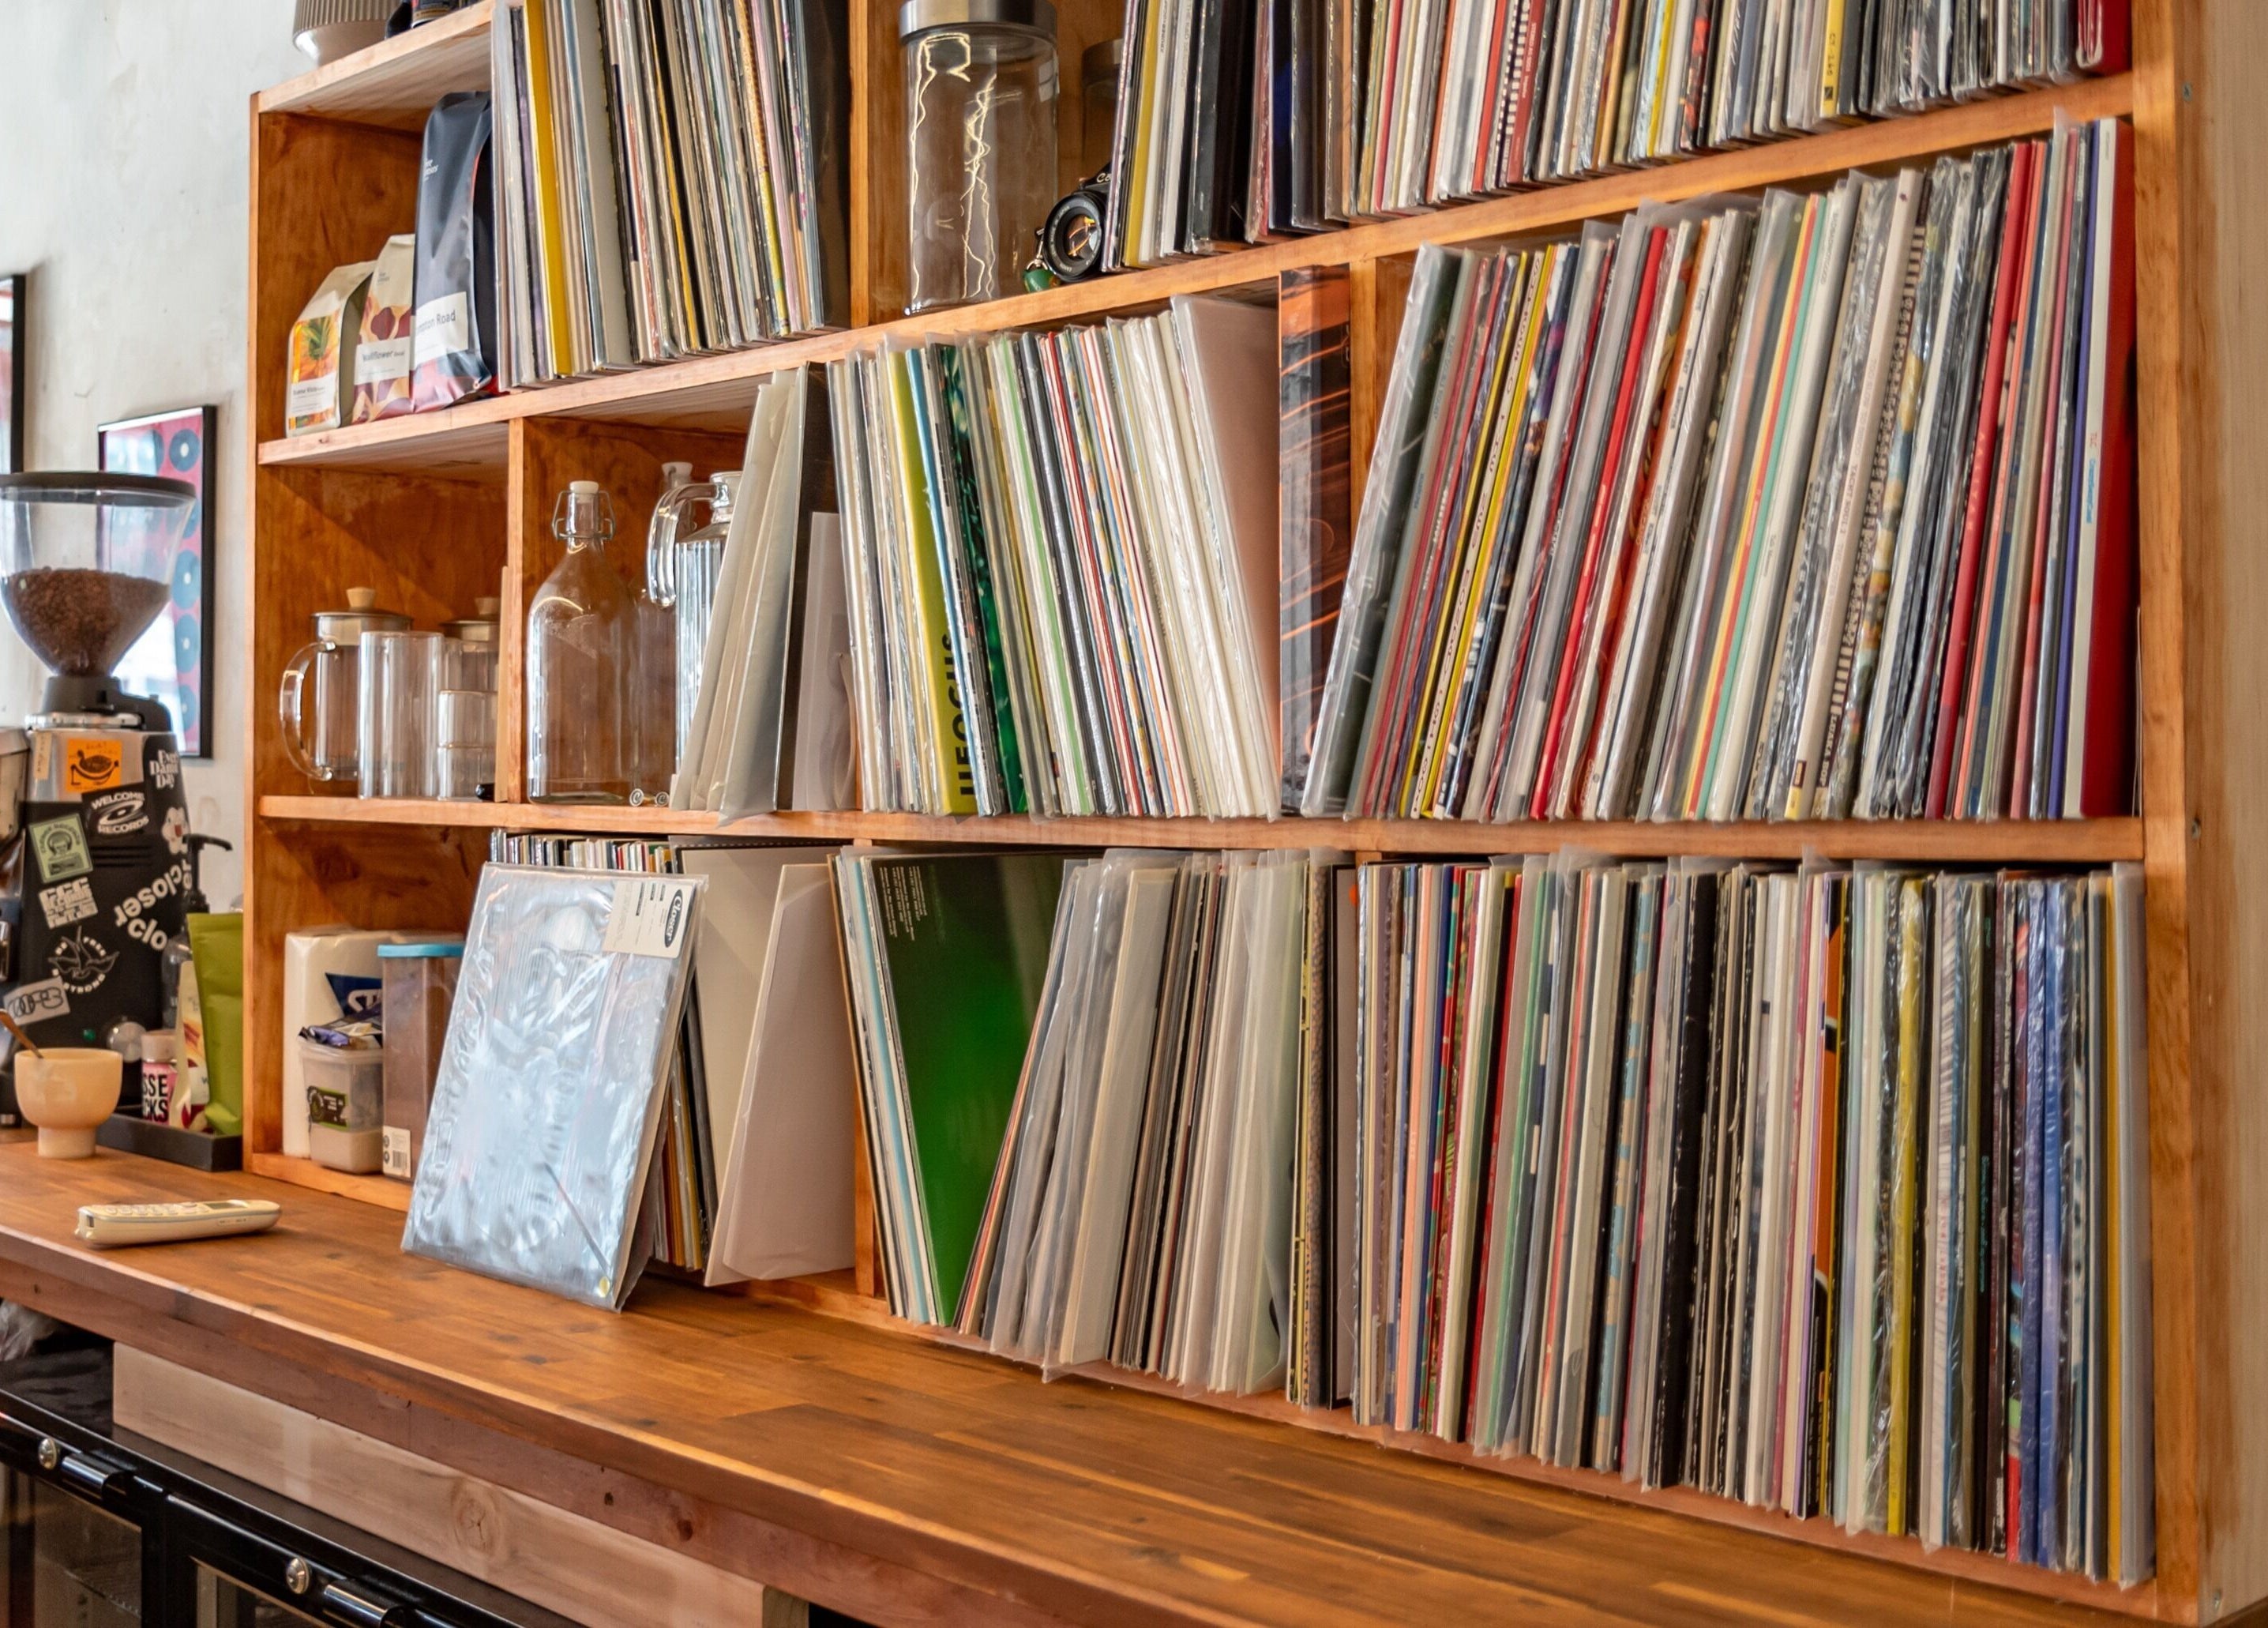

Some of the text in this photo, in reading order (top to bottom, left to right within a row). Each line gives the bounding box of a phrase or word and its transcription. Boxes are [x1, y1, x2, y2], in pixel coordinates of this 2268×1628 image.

[436, 310, 456, 325] Road
[1819, 761, 1828, 788] BOP
[91, 791, 145, 810] WELCOME
[97, 815, 149, 834] RECORDS
[667, 896, 682, 942] Closer
